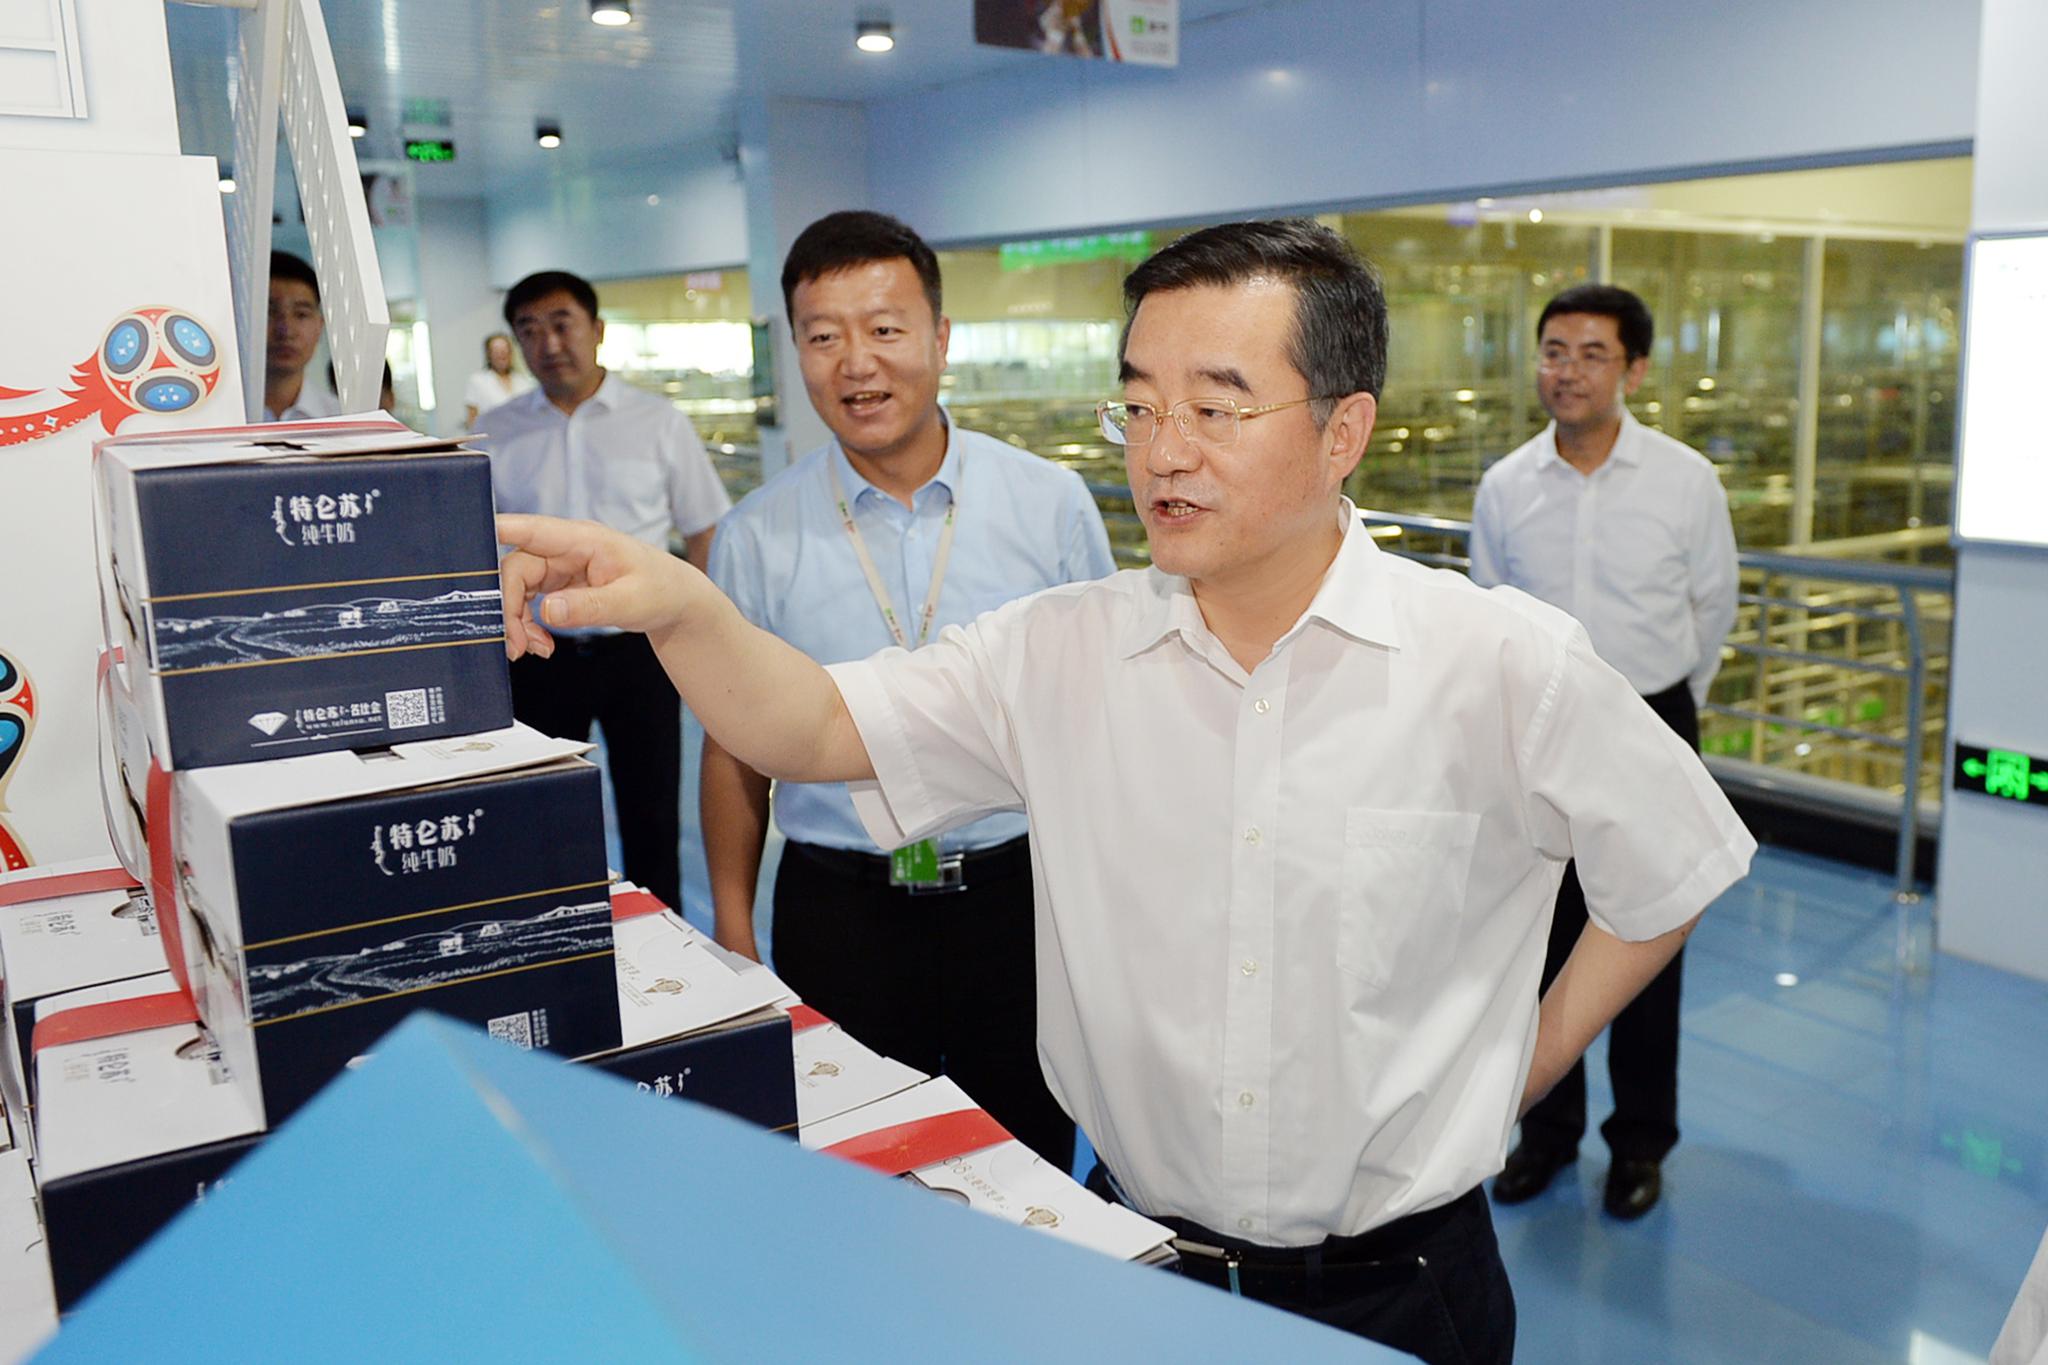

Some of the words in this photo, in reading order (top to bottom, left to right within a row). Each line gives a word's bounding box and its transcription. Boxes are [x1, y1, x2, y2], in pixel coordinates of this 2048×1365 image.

[289, 493, 362, 522] 特仑苏
[301, 521, 356, 545] 纯牛奶
[389, 815, 464, 850] 特仑苏
[401, 845, 457, 874] 纯牛奶
